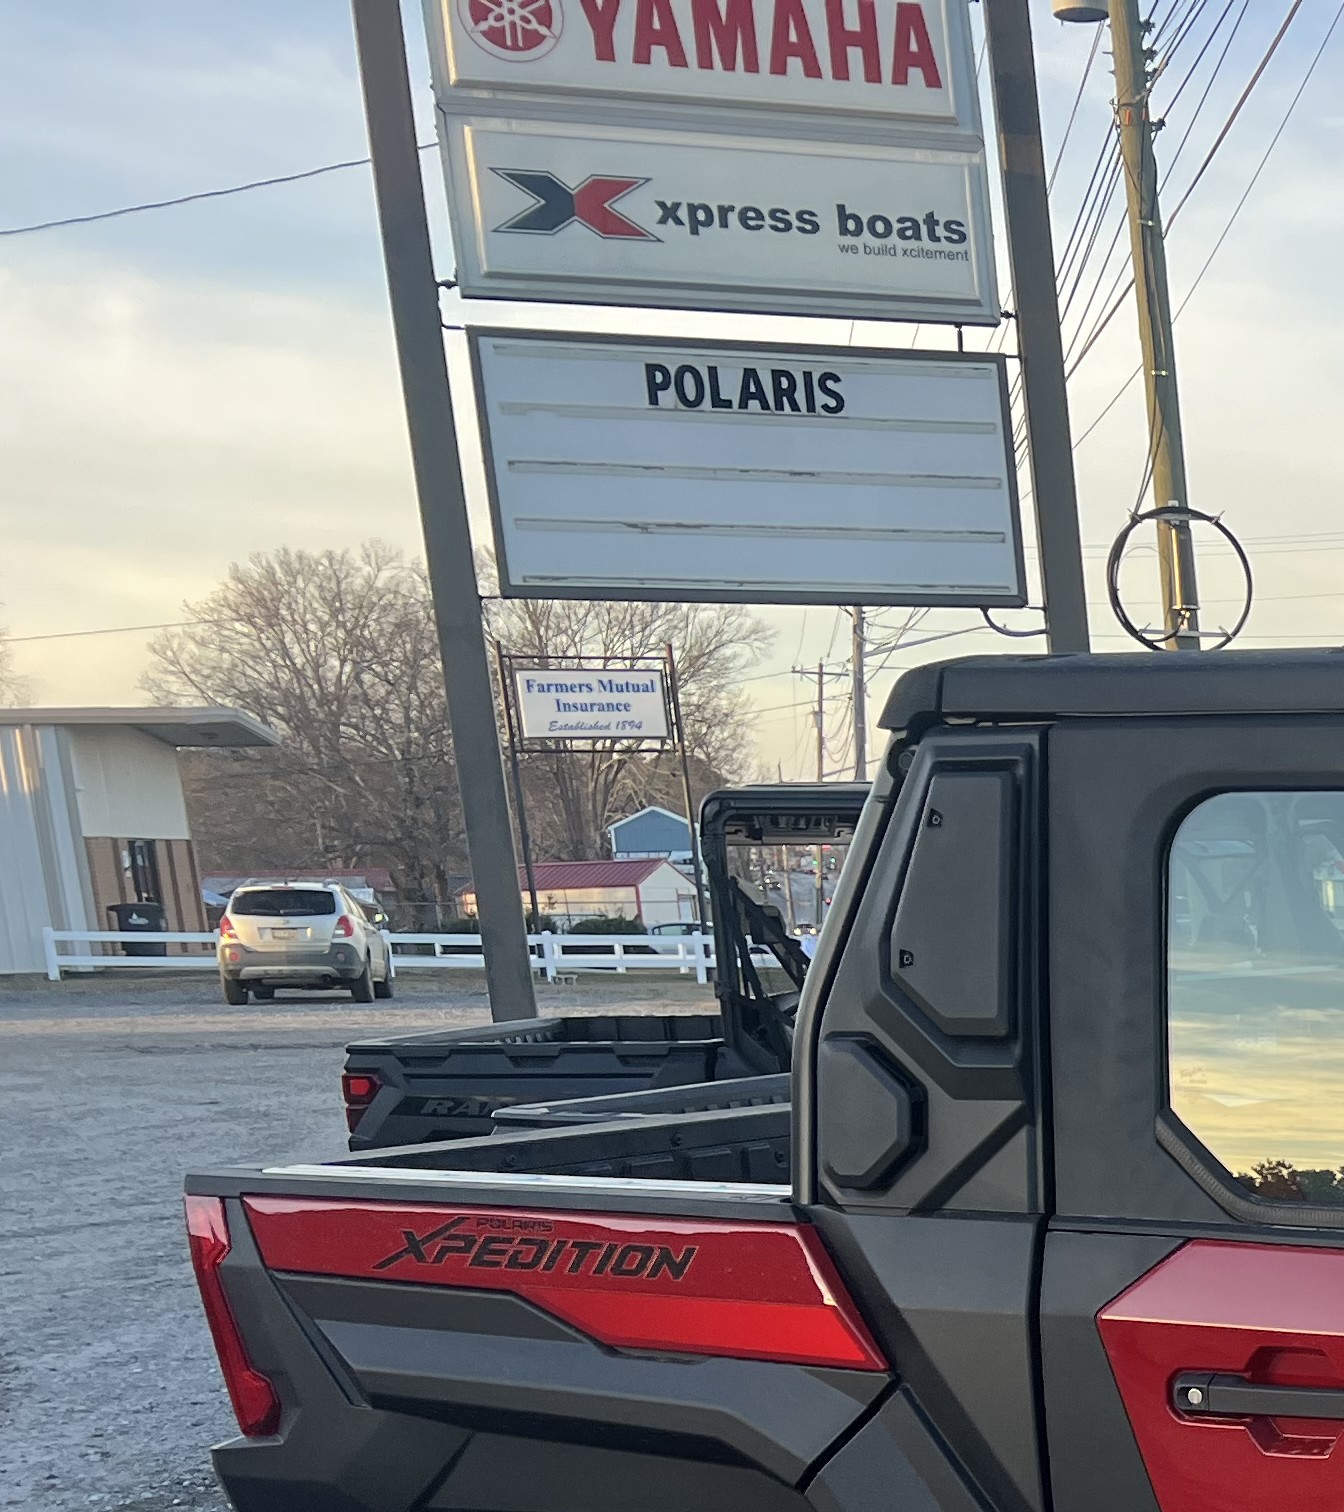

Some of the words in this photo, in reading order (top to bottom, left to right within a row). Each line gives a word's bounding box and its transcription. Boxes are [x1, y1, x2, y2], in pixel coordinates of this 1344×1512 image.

[580, 0, 943, 88] YAMAHA
[654, 200, 820, 236] xpress
[836, 204, 967, 245] boats
[838, 242, 859, 255] we
[863, 242, 897, 258] build
[901, 246, 969, 262] xcitement
[644, 362, 845, 415] POLARIS
[525, 678, 593, 693] Farmers
[597, 678, 656, 693] Mutual
[555, 698, 631, 713] Insurance
[548, 720, 611, 732] Established
[615, 720, 643, 731] 1894
[475, 1217, 555, 1232] POLARIS
[371, 1216, 700, 1282] XPEDITION
